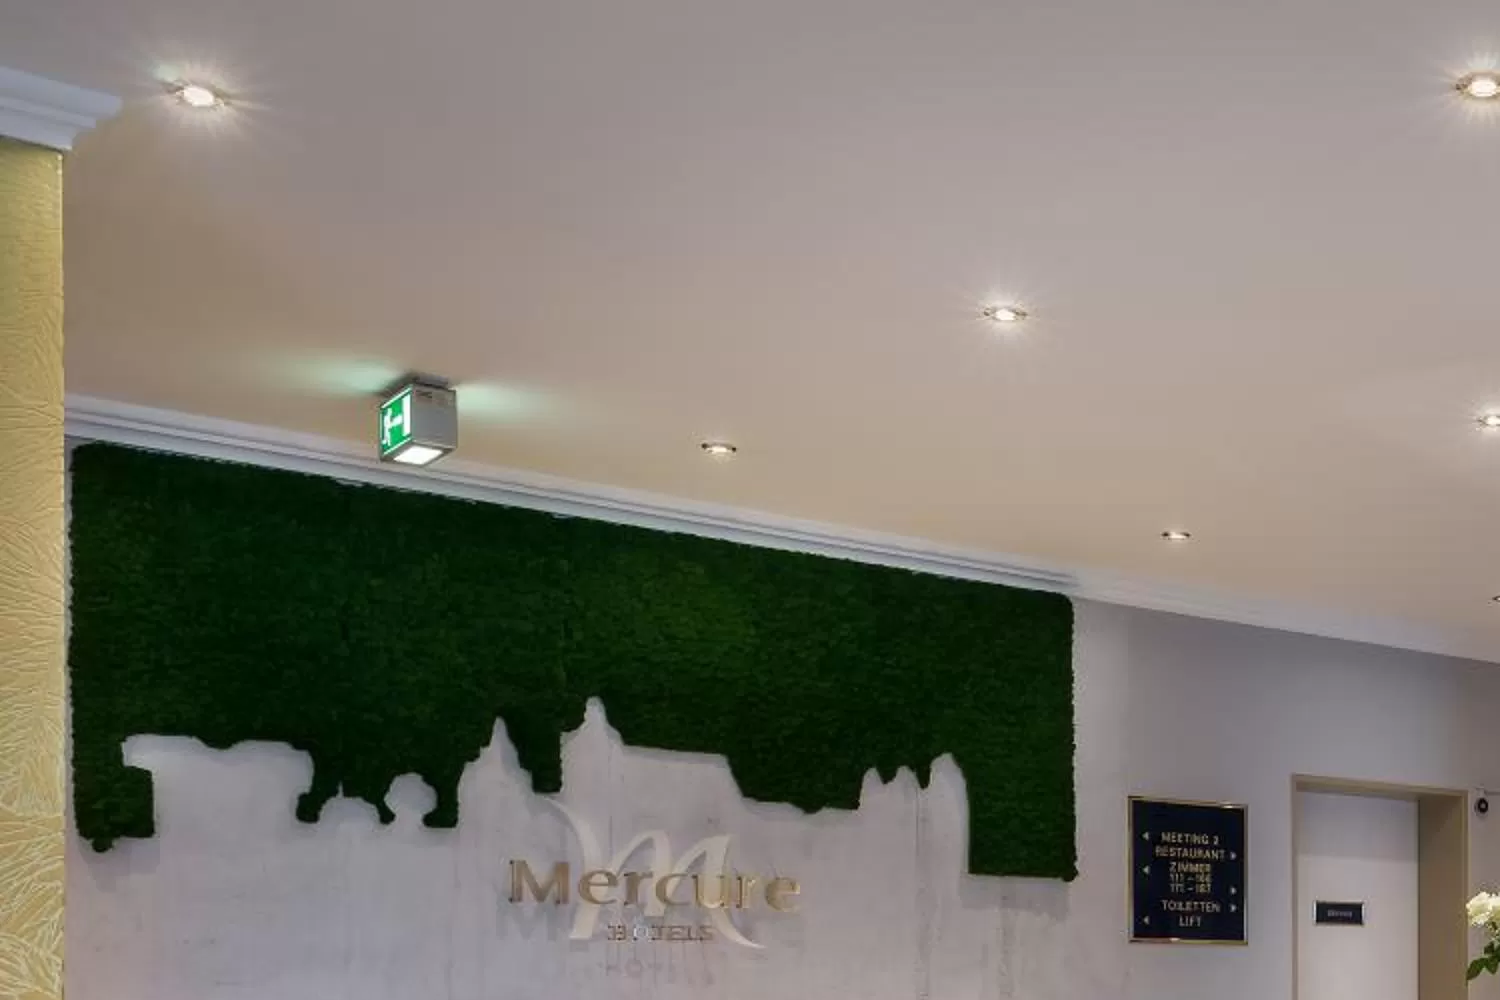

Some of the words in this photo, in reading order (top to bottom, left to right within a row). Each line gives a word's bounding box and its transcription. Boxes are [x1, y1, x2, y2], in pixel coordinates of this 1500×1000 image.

[1161, 831, 1209, 845] MEETING
[1155, 845, 1225, 861] RESTAURANT
[1168, 861, 1211, 873] ZIMMER
[509, 859, 801, 912] Mercure
[1161, 899, 1221, 913] TOILETTEN
[1179, 915, 1202, 927] LIFT
[607, 925, 713, 941] HOTELS
